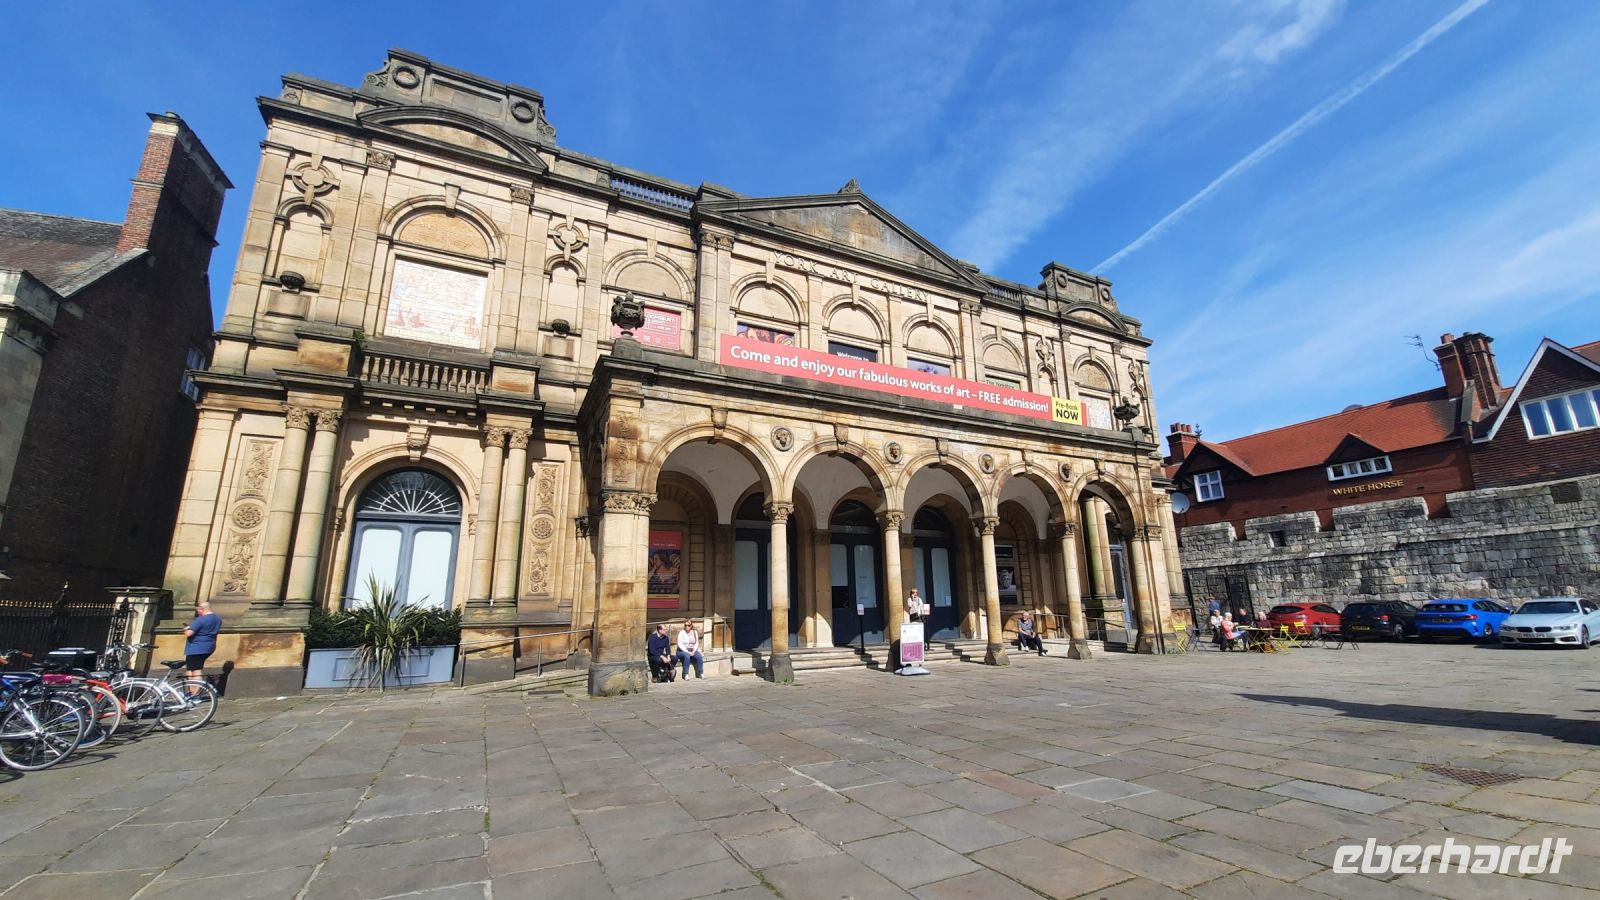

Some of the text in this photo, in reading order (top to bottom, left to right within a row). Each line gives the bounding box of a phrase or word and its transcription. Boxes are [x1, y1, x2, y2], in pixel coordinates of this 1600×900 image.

[773, 251, 929, 300] YORK ART GALLERY
[730, 345, 771, 363] Come
[773, 354, 799, 368] and
[800, 359, 836, 377] enjoy
[836, 366, 857, 379] our
[859, 367, 909, 388] fabulous
[909, 380, 942, 394] works
[943, 384, 955, 396] of
[956, 388, 971, 399] art
[978, 390, 1001, 405] FREE
[1002, 396, 1049, 413] admission!
[1055, 401, 1078, 411] Pre-Book
[1055, 408, 1079, 421] NOW
[1332, 480, 1405, 496] WHITE HORSE
